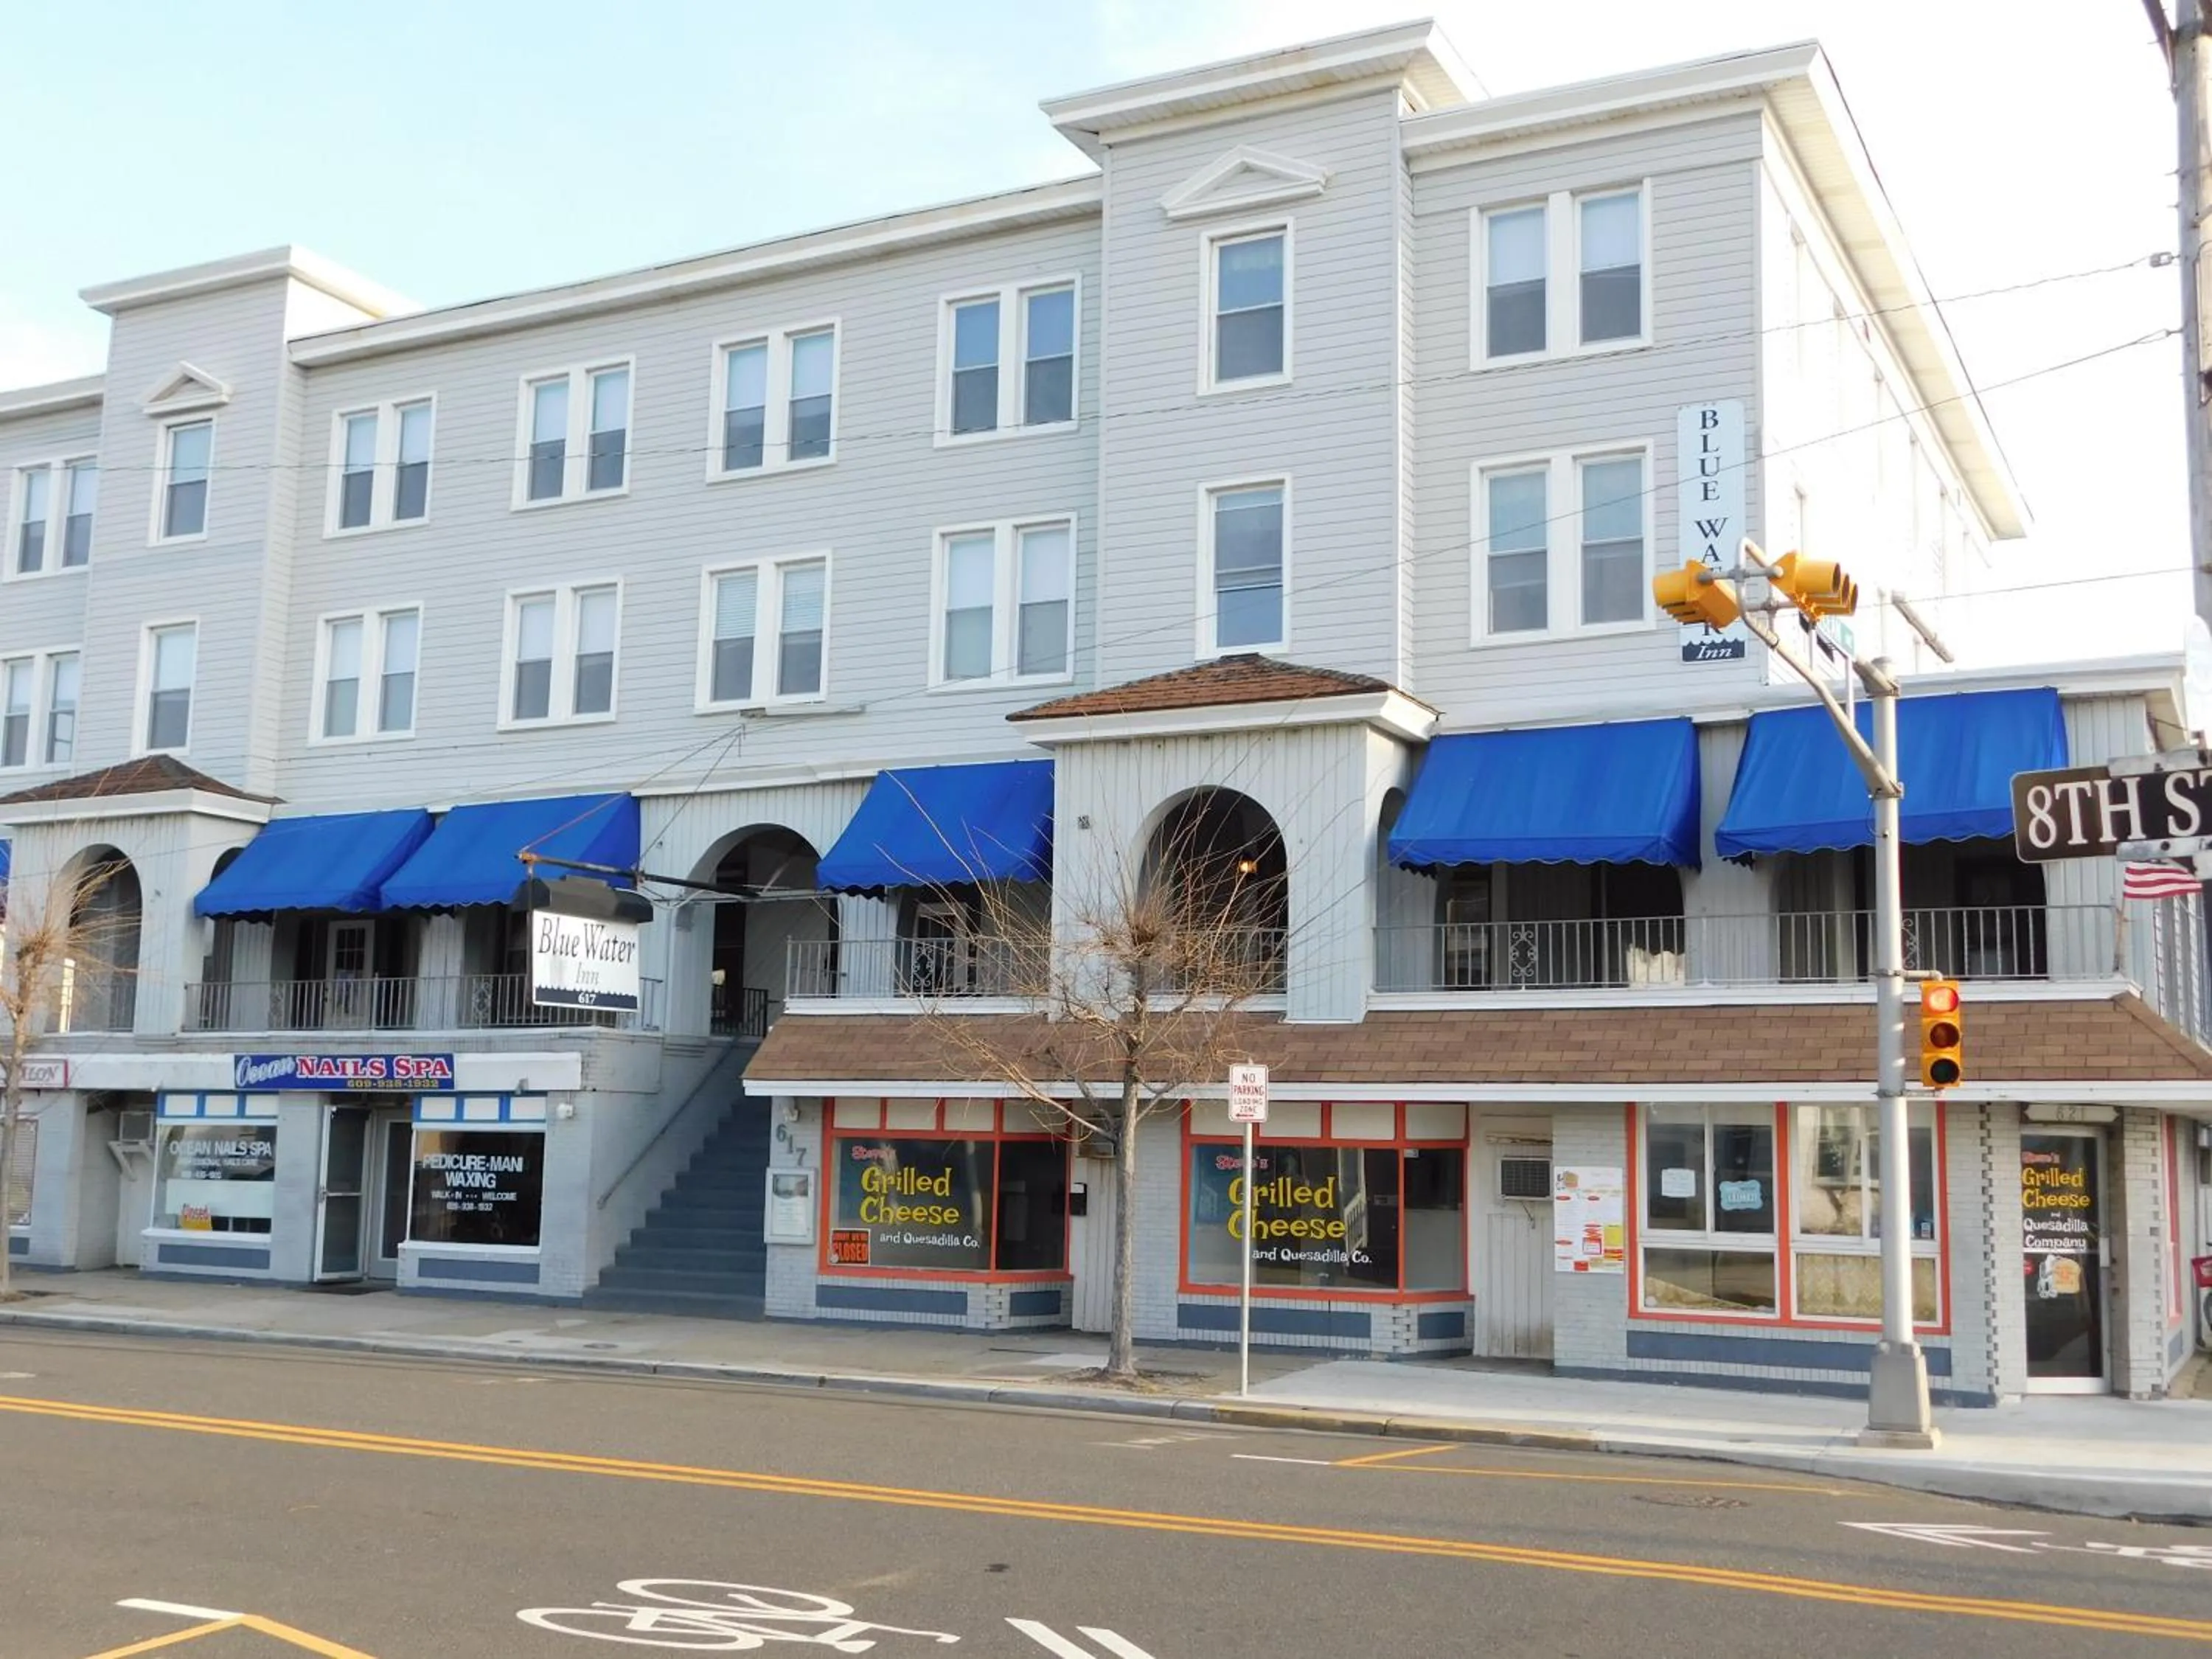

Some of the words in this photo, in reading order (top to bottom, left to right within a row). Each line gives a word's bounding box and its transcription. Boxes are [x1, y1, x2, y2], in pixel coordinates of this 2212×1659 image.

[1698, 409, 1721, 501] BLUE
[1697, 646, 1732, 660] Inn
[2027, 776, 2147, 849] 8TH
[538, 917, 580, 957] Blue
[583, 922, 636, 964] Water
[575, 961, 600, 986] Inn
[577, 992, 597, 1004] 617
[236, 1056, 296, 1088] Ocean
[296, 1055, 386, 1079] NAILS
[393, 1055, 452, 1079] SPA
[1241, 1073, 1256, 1083] NO
[1234, 1085, 1265, 1096] PARKING
[169, 1140, 212, 1155] OCEAN
[214, 1140, 248, 1156] NAILS
[248, 1141, 272, 1157] SPA
[776, 1123, 807, 1166] 617
[445, 1171, 497, 1189] WAXING
[860, 1165, 953, 1197] Grilled
[2022, 1167, 2084, 1188] Grilled
[2022, 1188, 2091, 1208] Cheese
[859, 1195, 960, 1225] Cheese
[1227, 1208, 1346, 1240] Cheese
[2023, 1217, 2090, 1233] Quesadilla
[880, 1231, 901, 1244] and
[903, 1232, 960, 1247] Quesadilla
[2025, 1234, 2087, 1252] Company
[1252, 1247, 1277, 1261] and
[1280, 1248, 1349, 1263] Quesadilla
[1352, 1251, 1373, 1264] Co.
